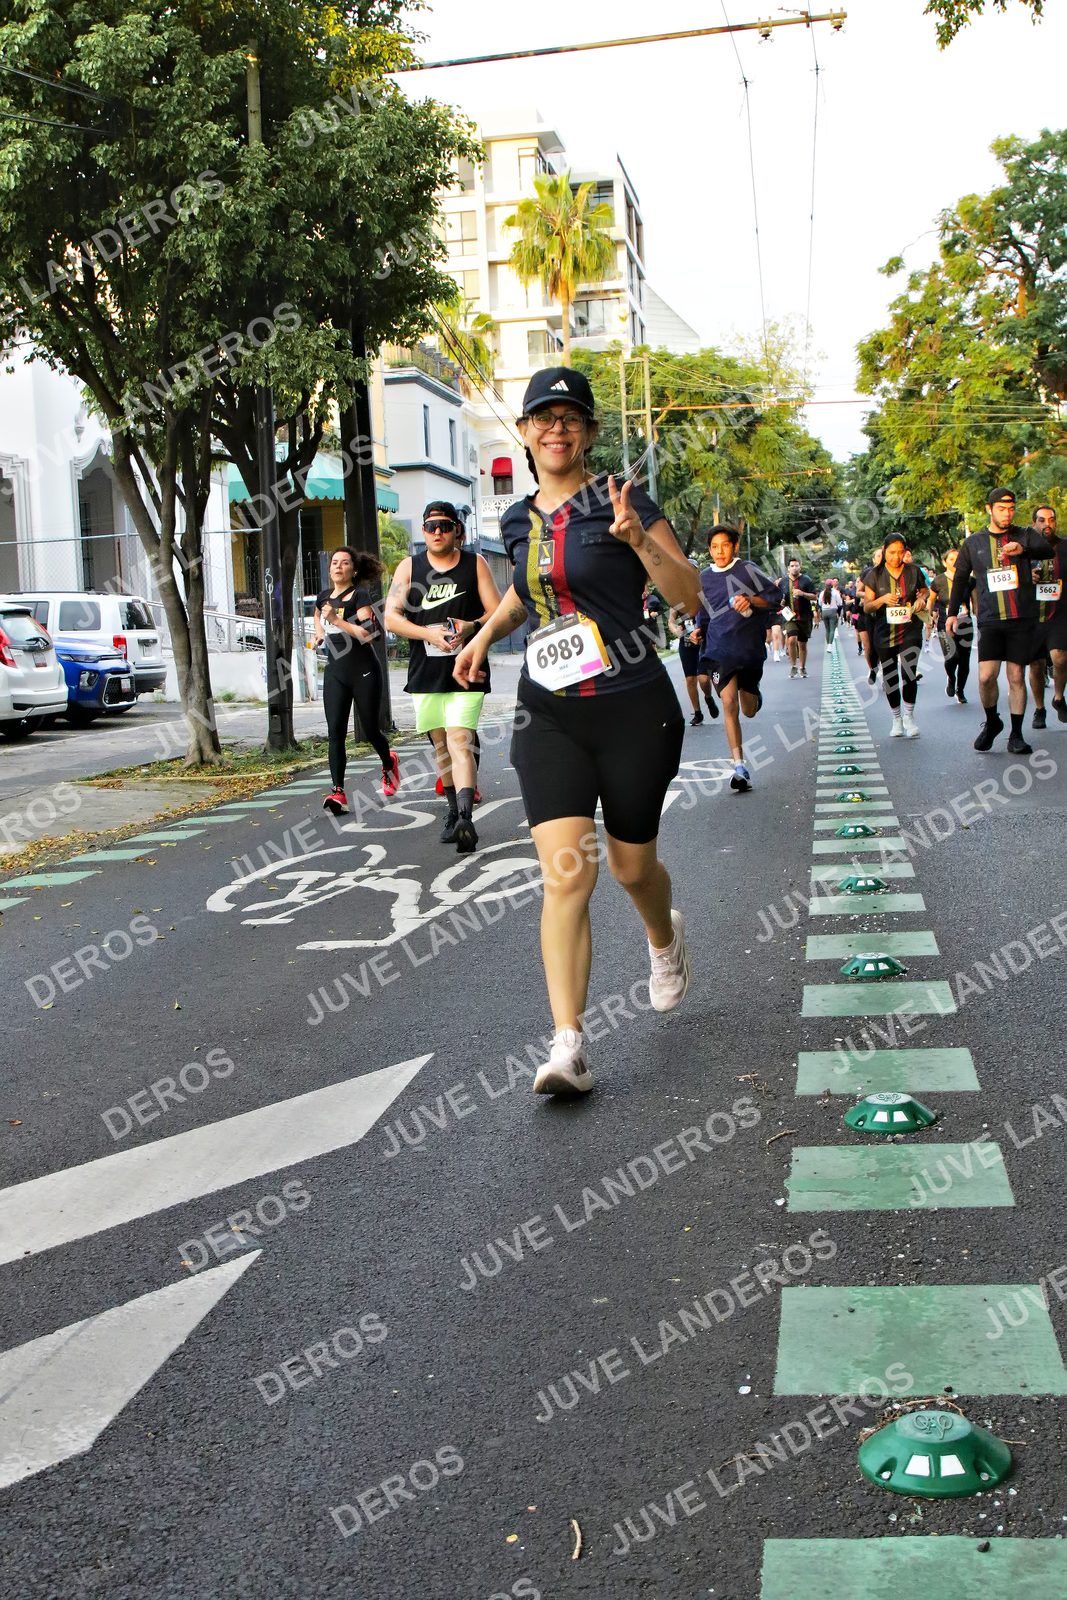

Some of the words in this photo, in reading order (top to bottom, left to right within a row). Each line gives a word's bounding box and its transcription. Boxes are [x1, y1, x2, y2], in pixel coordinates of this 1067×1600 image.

[992, 574, 1012, 583] 1583
[428, 583, 458, 598] RUN
[536, 634, 584, 669] 6989
